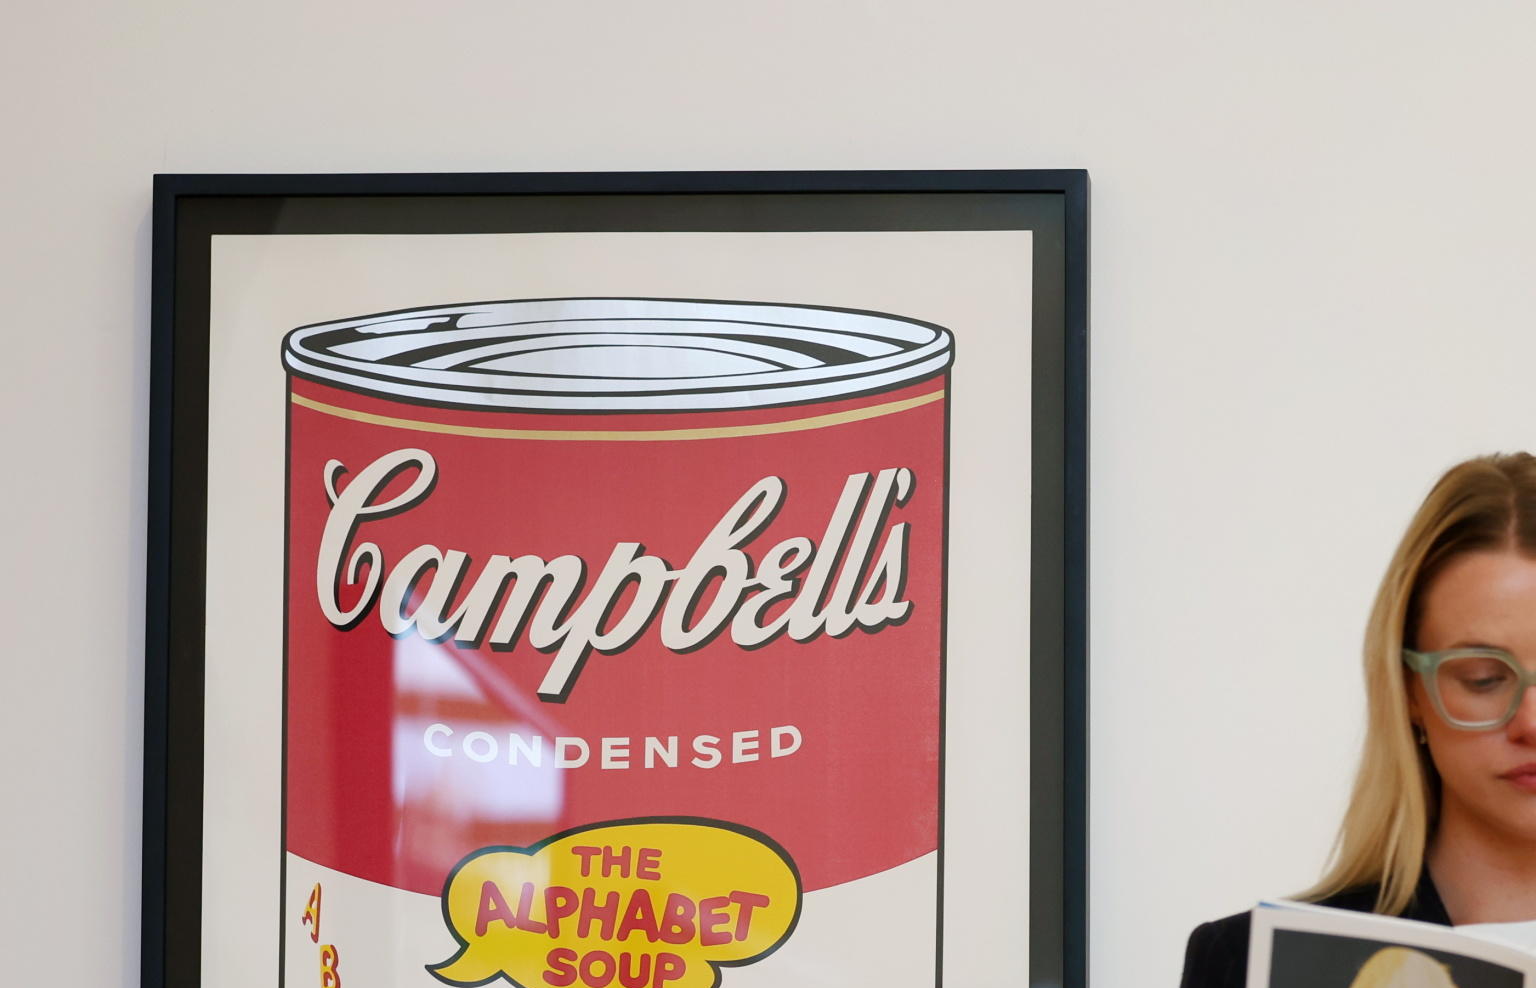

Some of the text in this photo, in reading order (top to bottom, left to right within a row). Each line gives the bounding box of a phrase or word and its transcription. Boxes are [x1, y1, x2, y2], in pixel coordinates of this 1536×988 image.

[316, 448, 912, 703] Campbell's
[423, 723, 803, 770] CONDENSED
[571, 845, 663, 881] THE
[475, 881, 770, 946] ALPHABET
